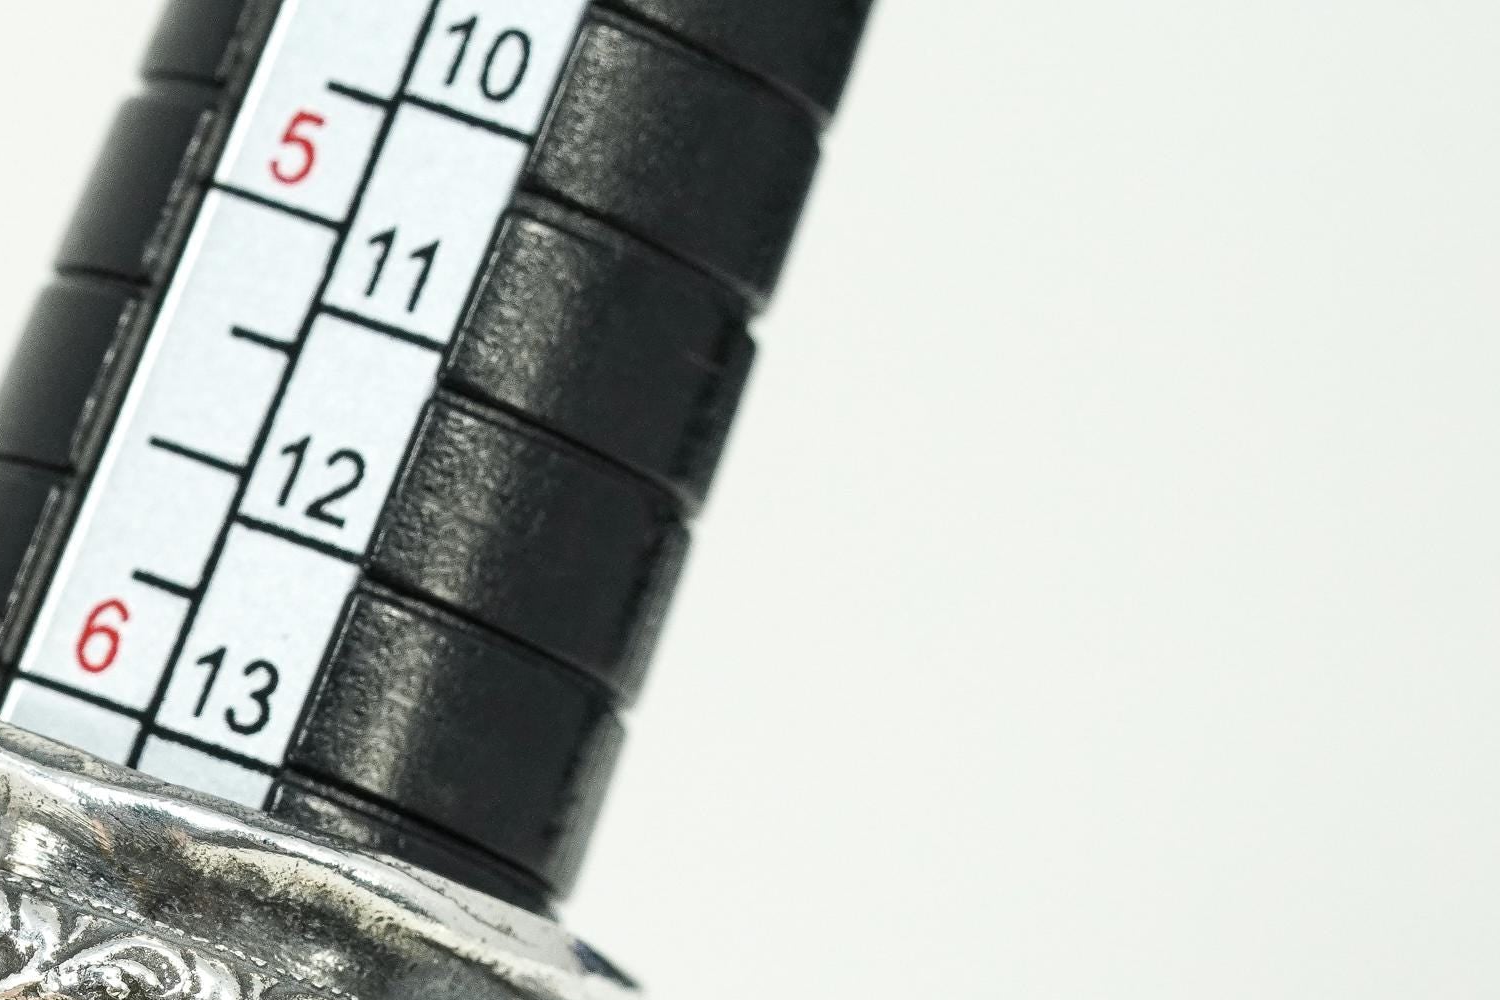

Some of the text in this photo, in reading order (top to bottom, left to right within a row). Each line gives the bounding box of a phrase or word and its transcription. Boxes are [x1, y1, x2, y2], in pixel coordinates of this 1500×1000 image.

[443, 16, 532, 102] 10
[268, 110, 328, 186] 5
[365, 229, 441, 314] 11
[277, 436, 367, 529] 12
[75, 599, 131, 675] 6
[191, 647, 280, 737] 13
